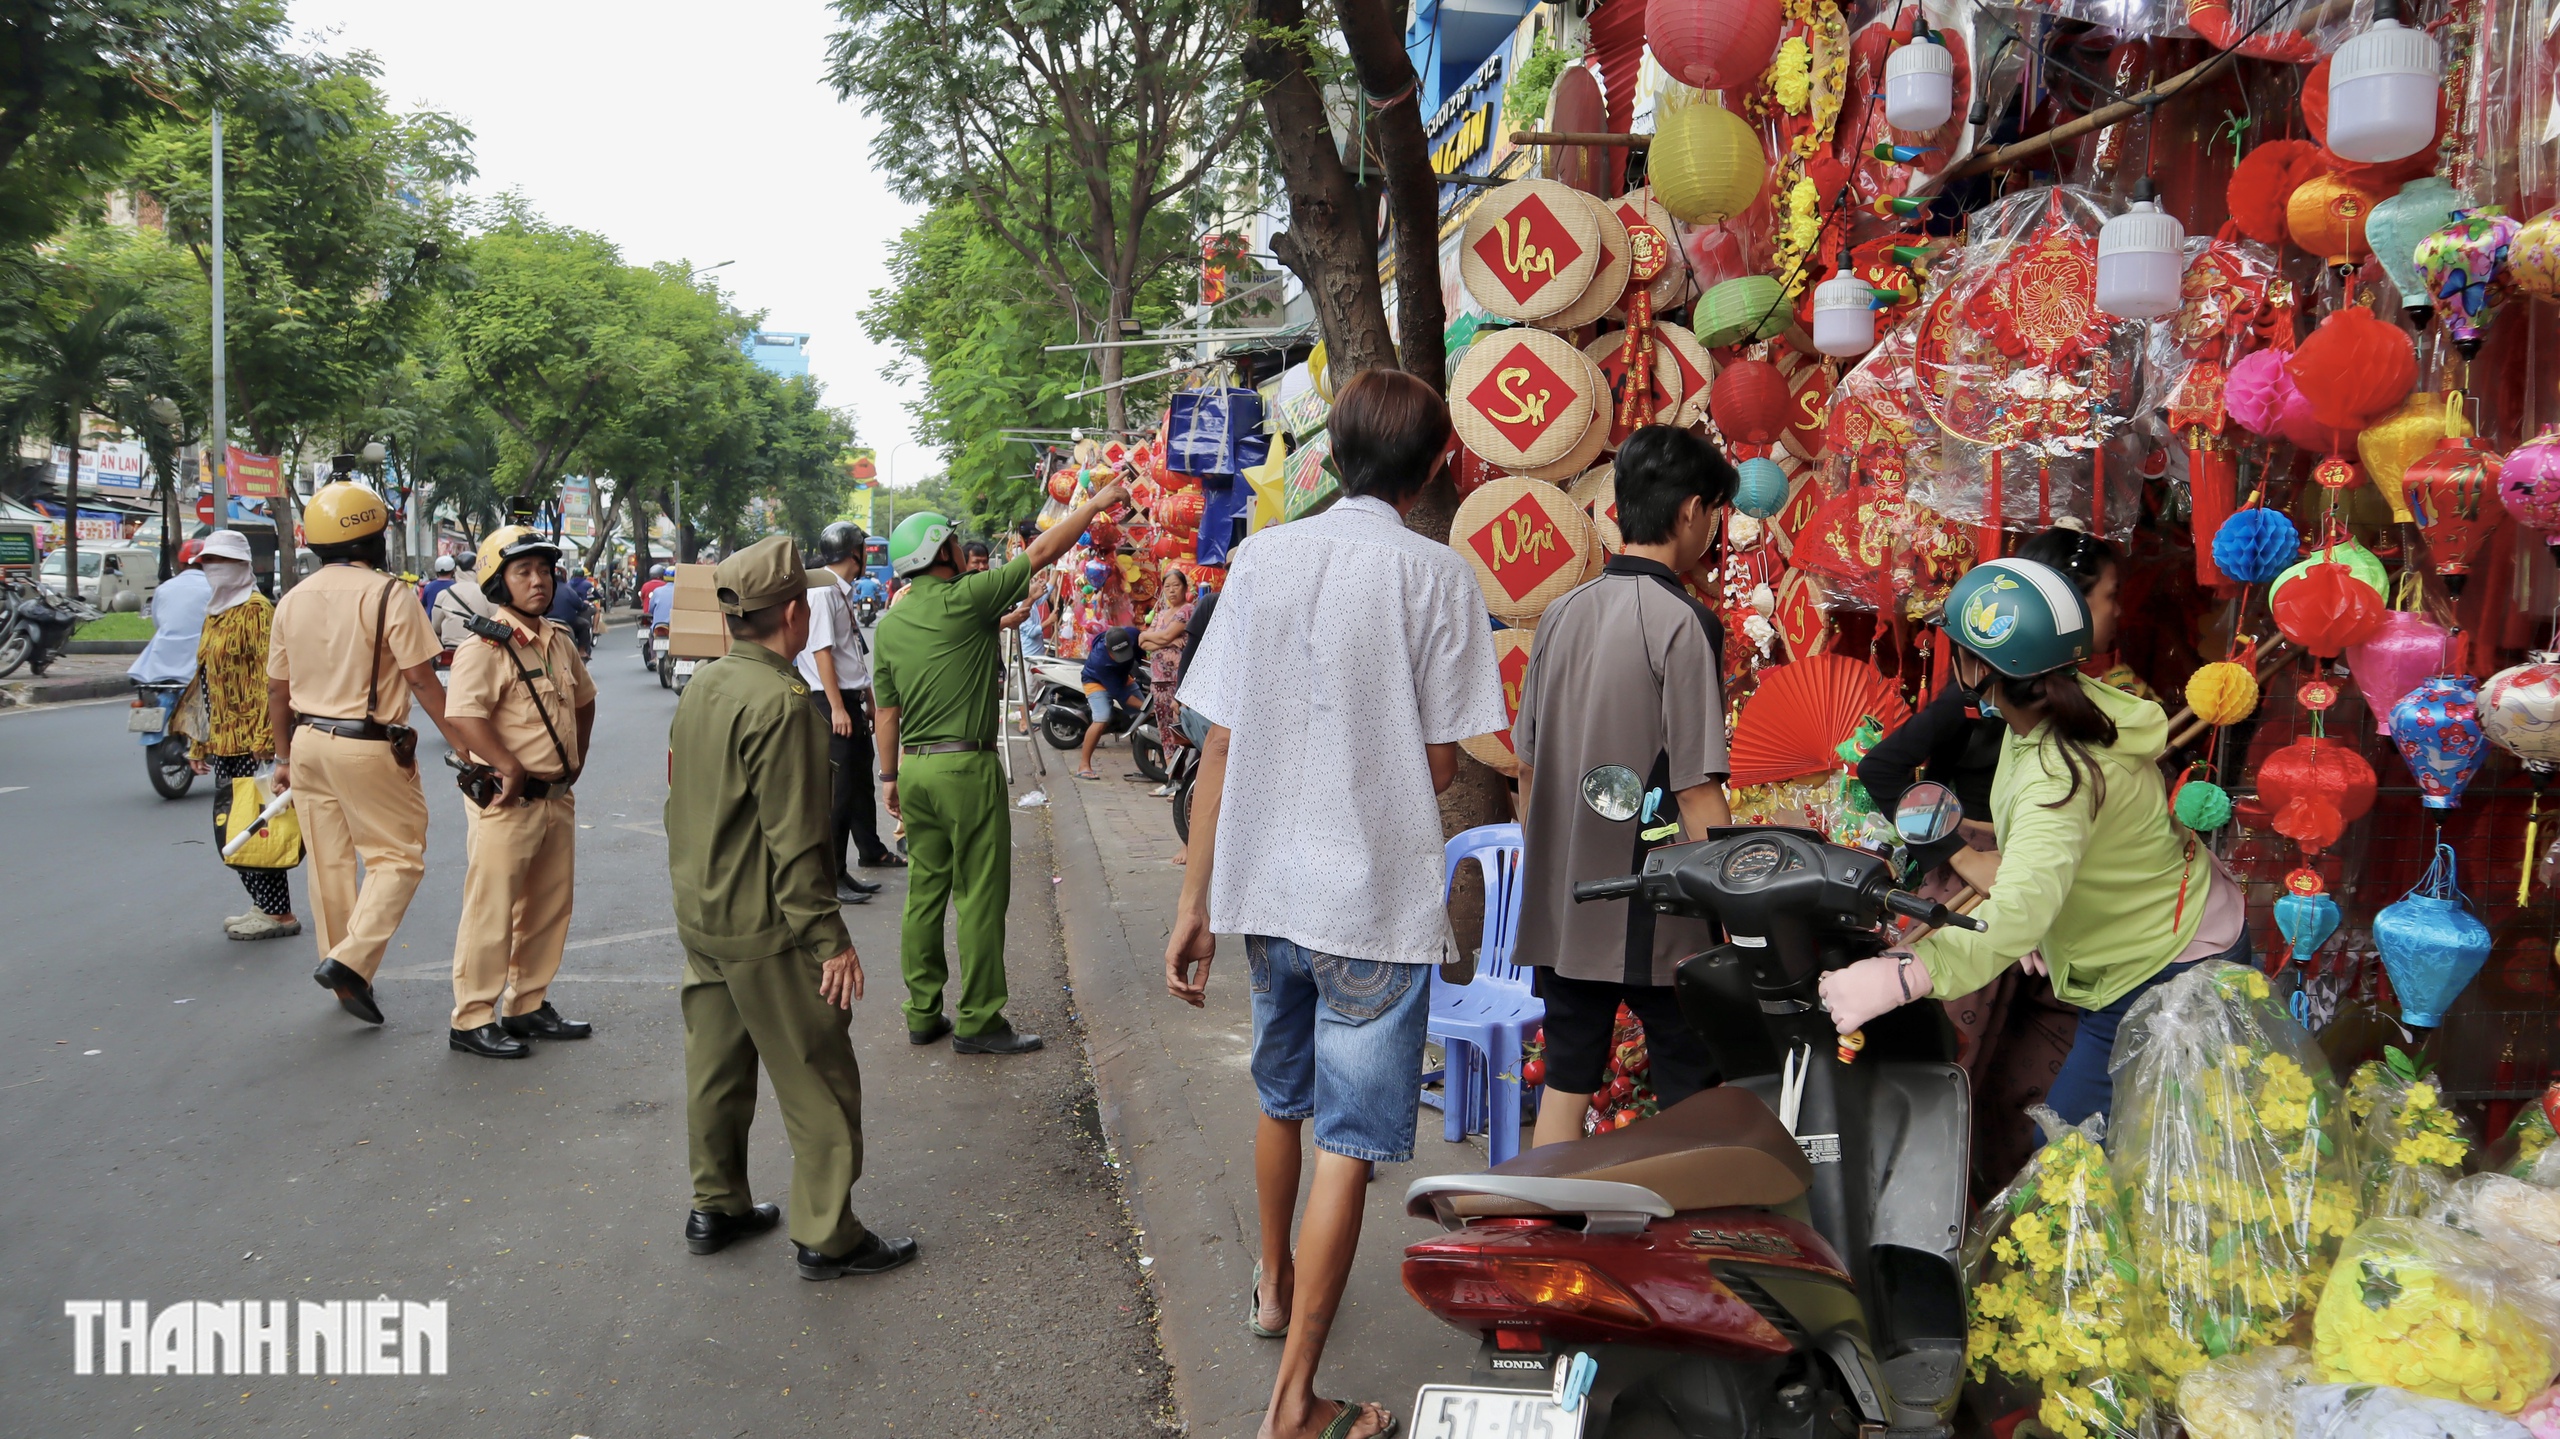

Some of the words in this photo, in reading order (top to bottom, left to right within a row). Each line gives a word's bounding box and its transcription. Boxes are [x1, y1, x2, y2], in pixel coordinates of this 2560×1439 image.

[1449, 86, 1468, 117] 210
[1477, 55, 1501, 90] 212
[1494, 216, 1557, 283] Vạn
[119, 456, 138, 472] LAN
[2323, 465, 2345, 483] 福
[340, 508, 377, 528] CSGT
[1932, 533, 1966, 561] Lộc
[1492, 1359, 1545, 1370] HONDA
